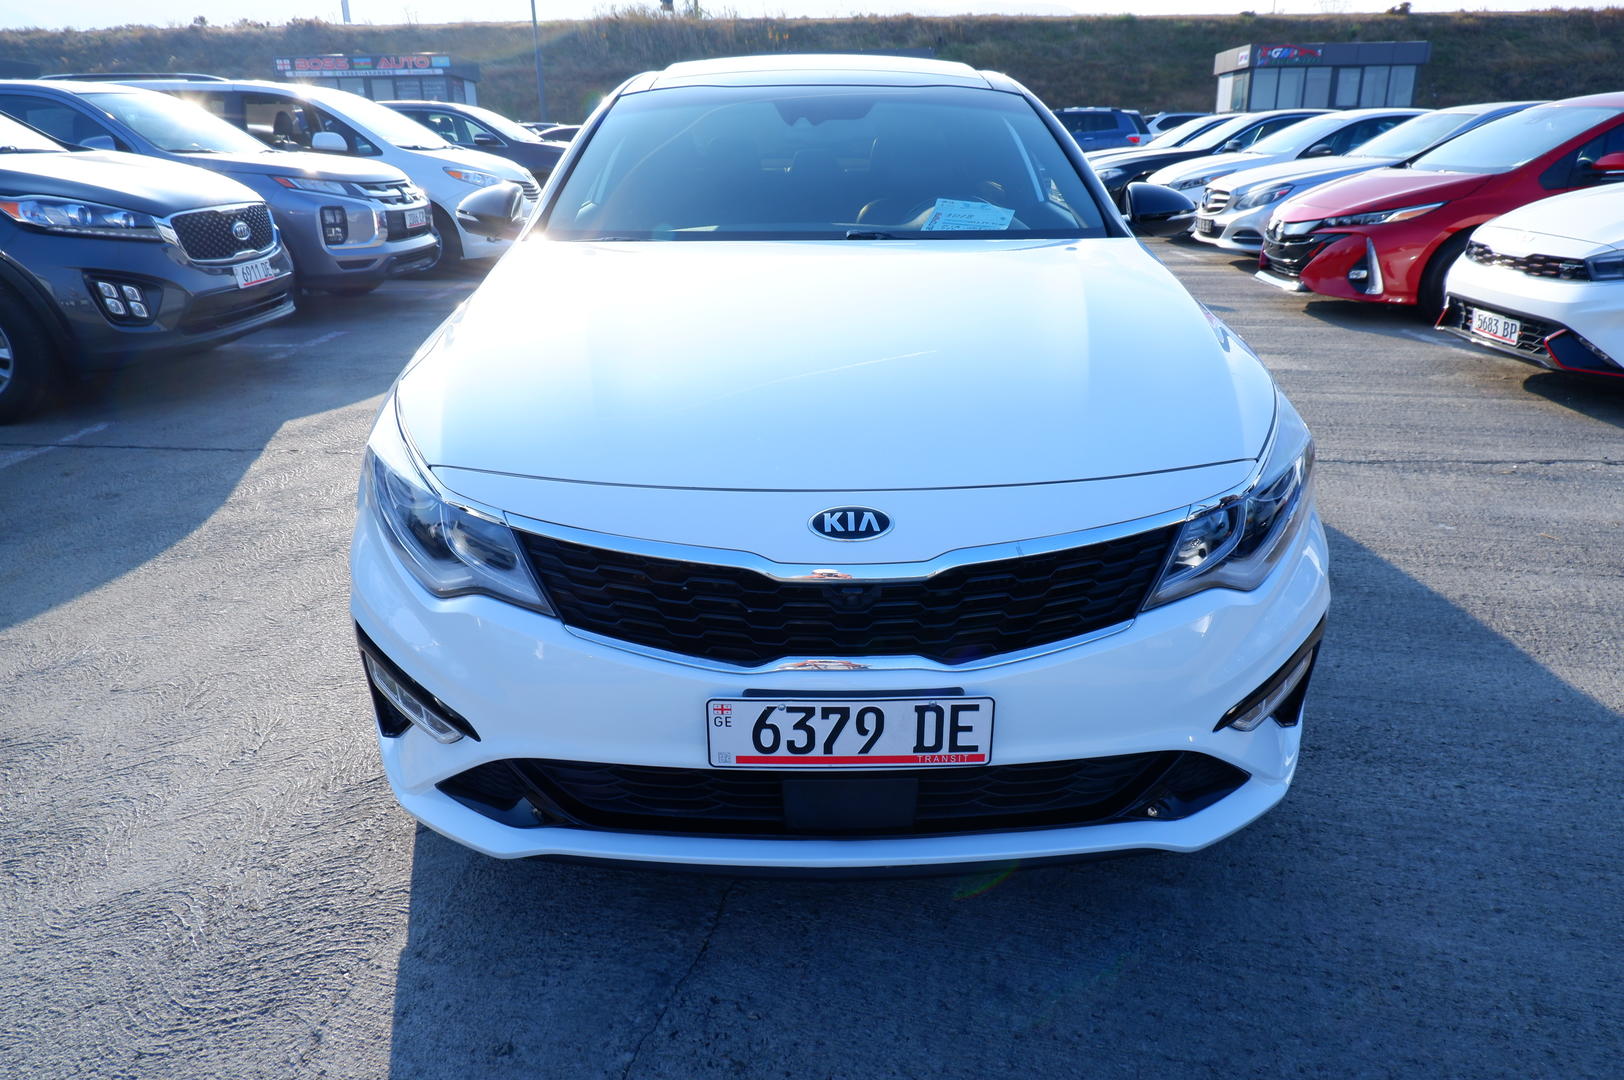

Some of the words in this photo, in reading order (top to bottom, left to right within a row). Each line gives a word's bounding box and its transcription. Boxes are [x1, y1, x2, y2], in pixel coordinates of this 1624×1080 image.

[294, 58, 349, 71] BOSS
[376, 56, 430, 69] AUTO
[241, 264, 262, 283] 6911
[1477, 314, 1499, 335] 5683
[1502, 321, 1517, 340] BP
[823, 511, 881, 533] KIA
[713, 716, 732, 728] GE
[752, 706, 886, 755] 6379
[912, 704, 980, 754] DE
[917, 754, 970, 764] TRANSIT
